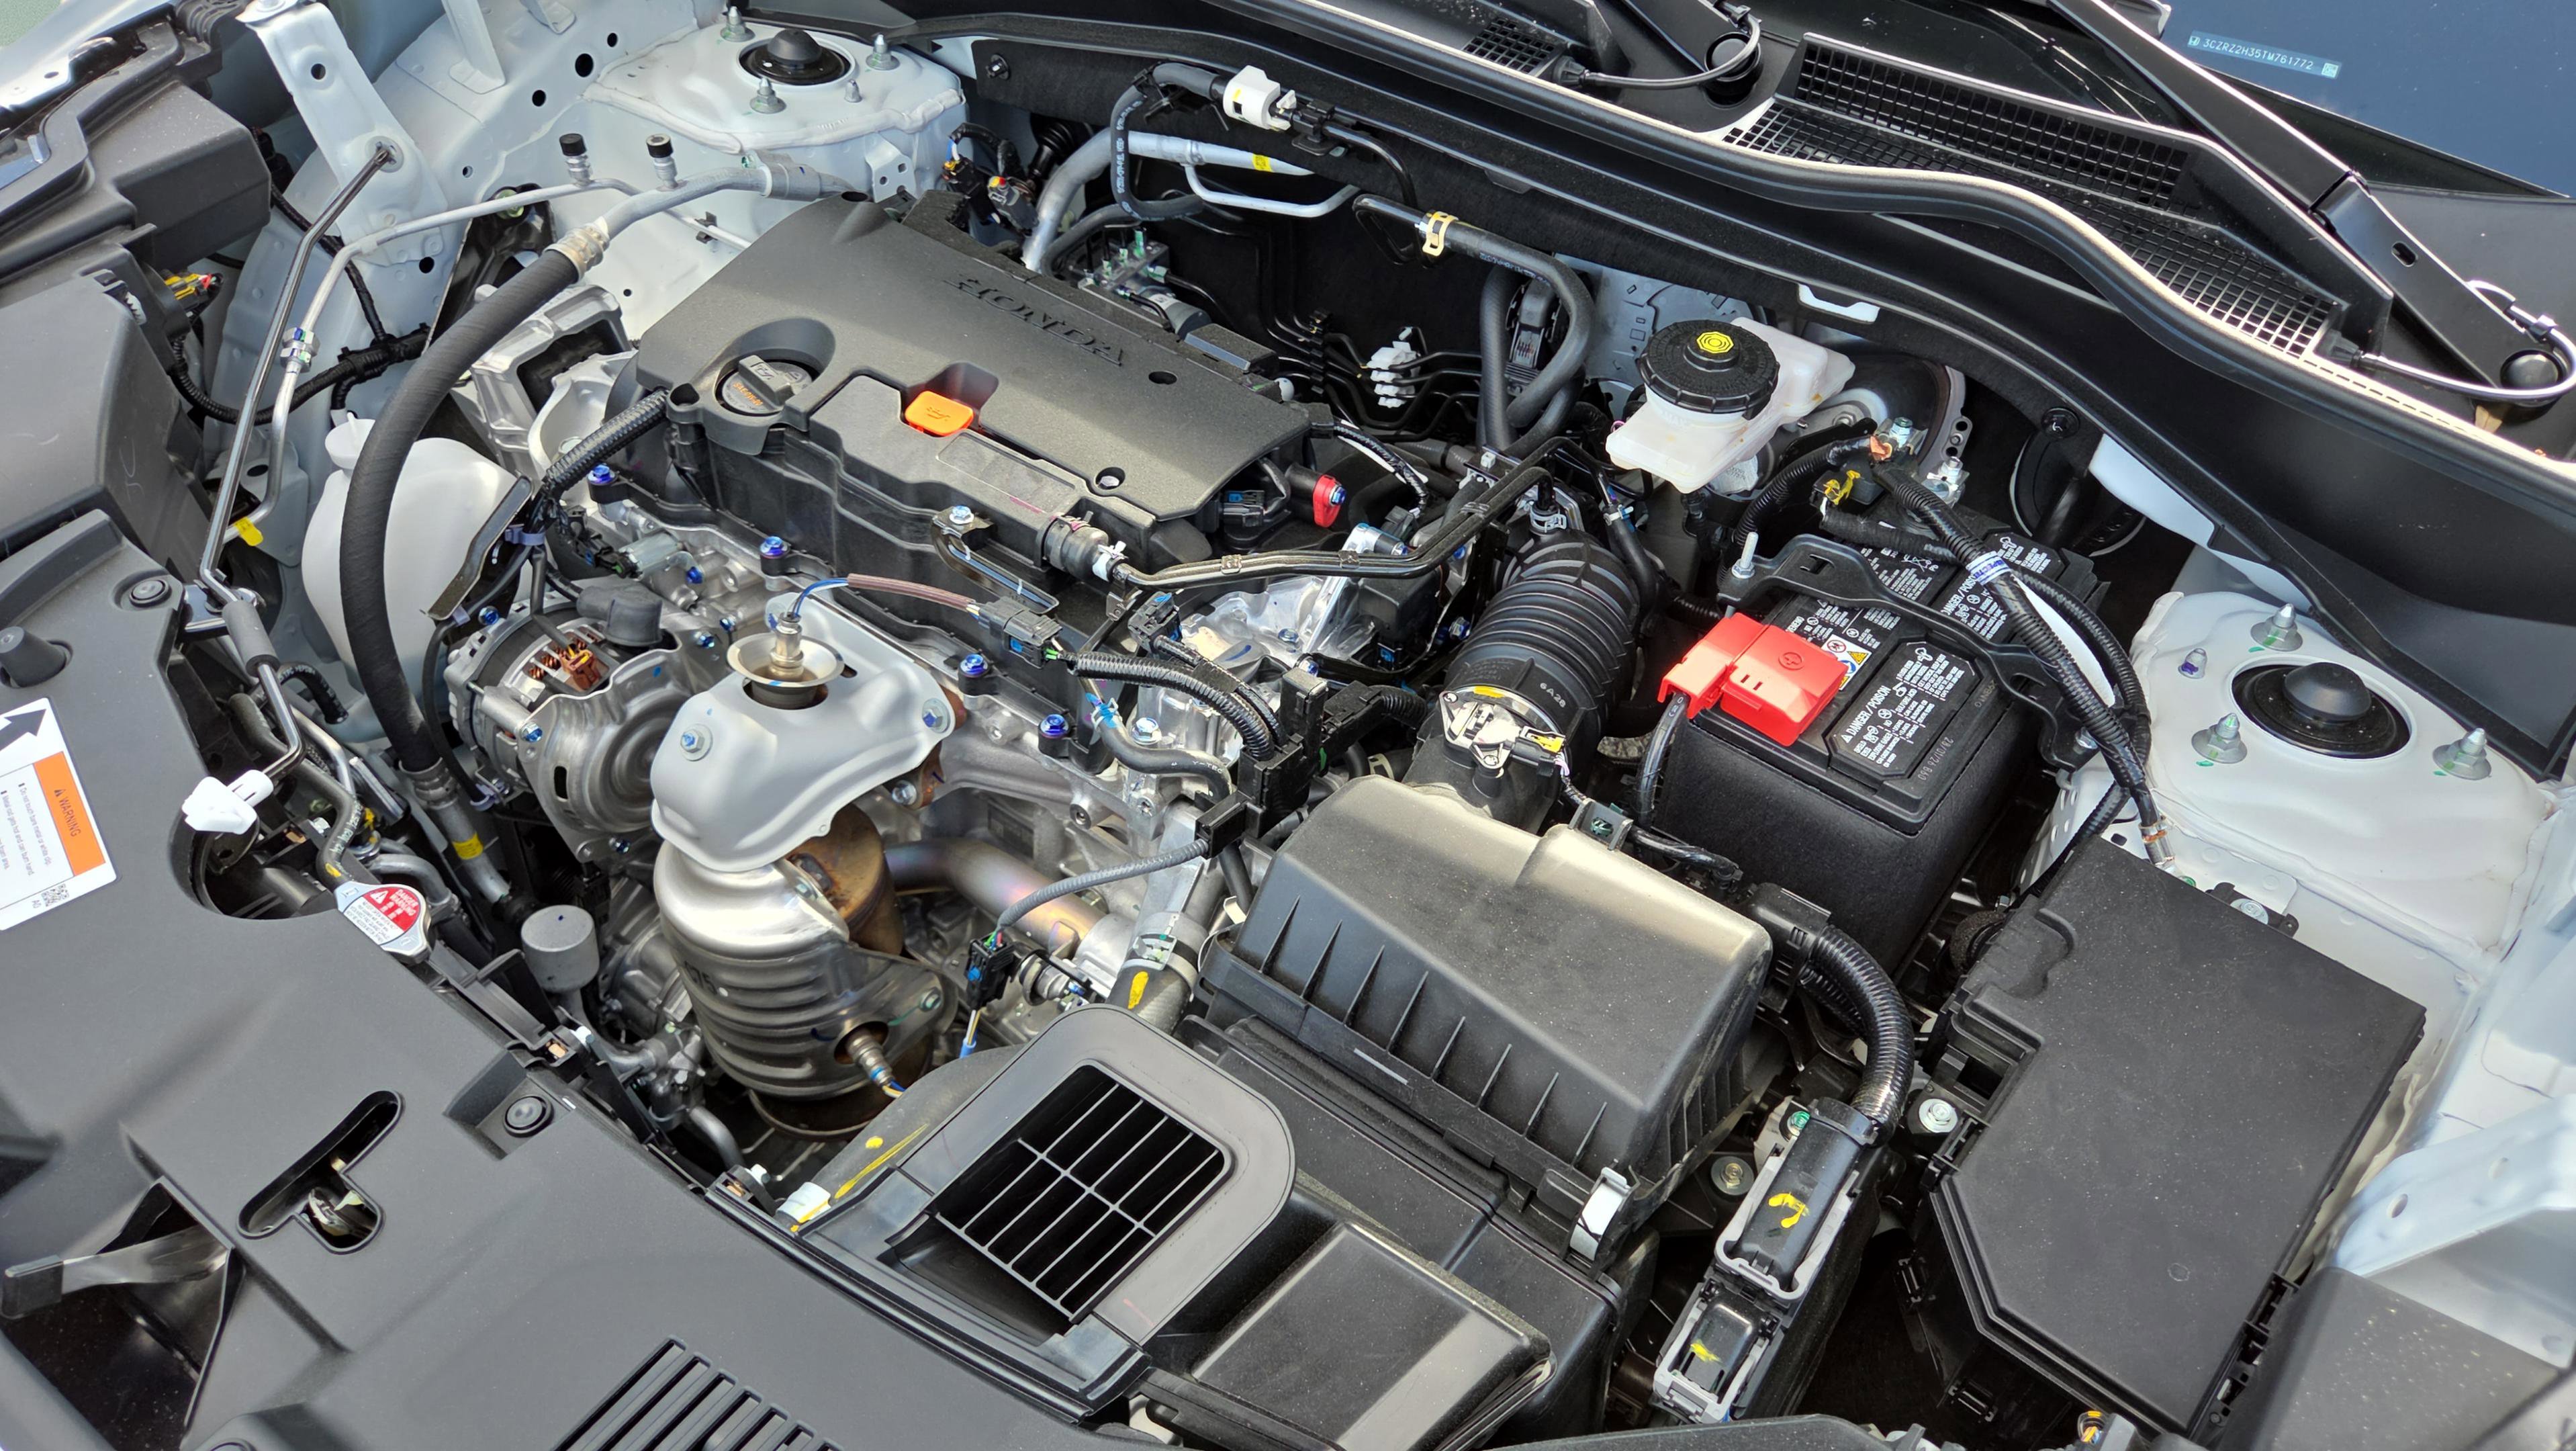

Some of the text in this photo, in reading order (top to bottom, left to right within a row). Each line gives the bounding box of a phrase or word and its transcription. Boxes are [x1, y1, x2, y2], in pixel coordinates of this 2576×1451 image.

[2203, 38, 2313, 70] 3CZRZ2H35TM761772
[943, 274, 1124, 367] HONDA
[1845, 709, 1872, 736] DANGER
[1866, 684, 1892, 709] POISON
[59, 797, 81, 837] WARNING
